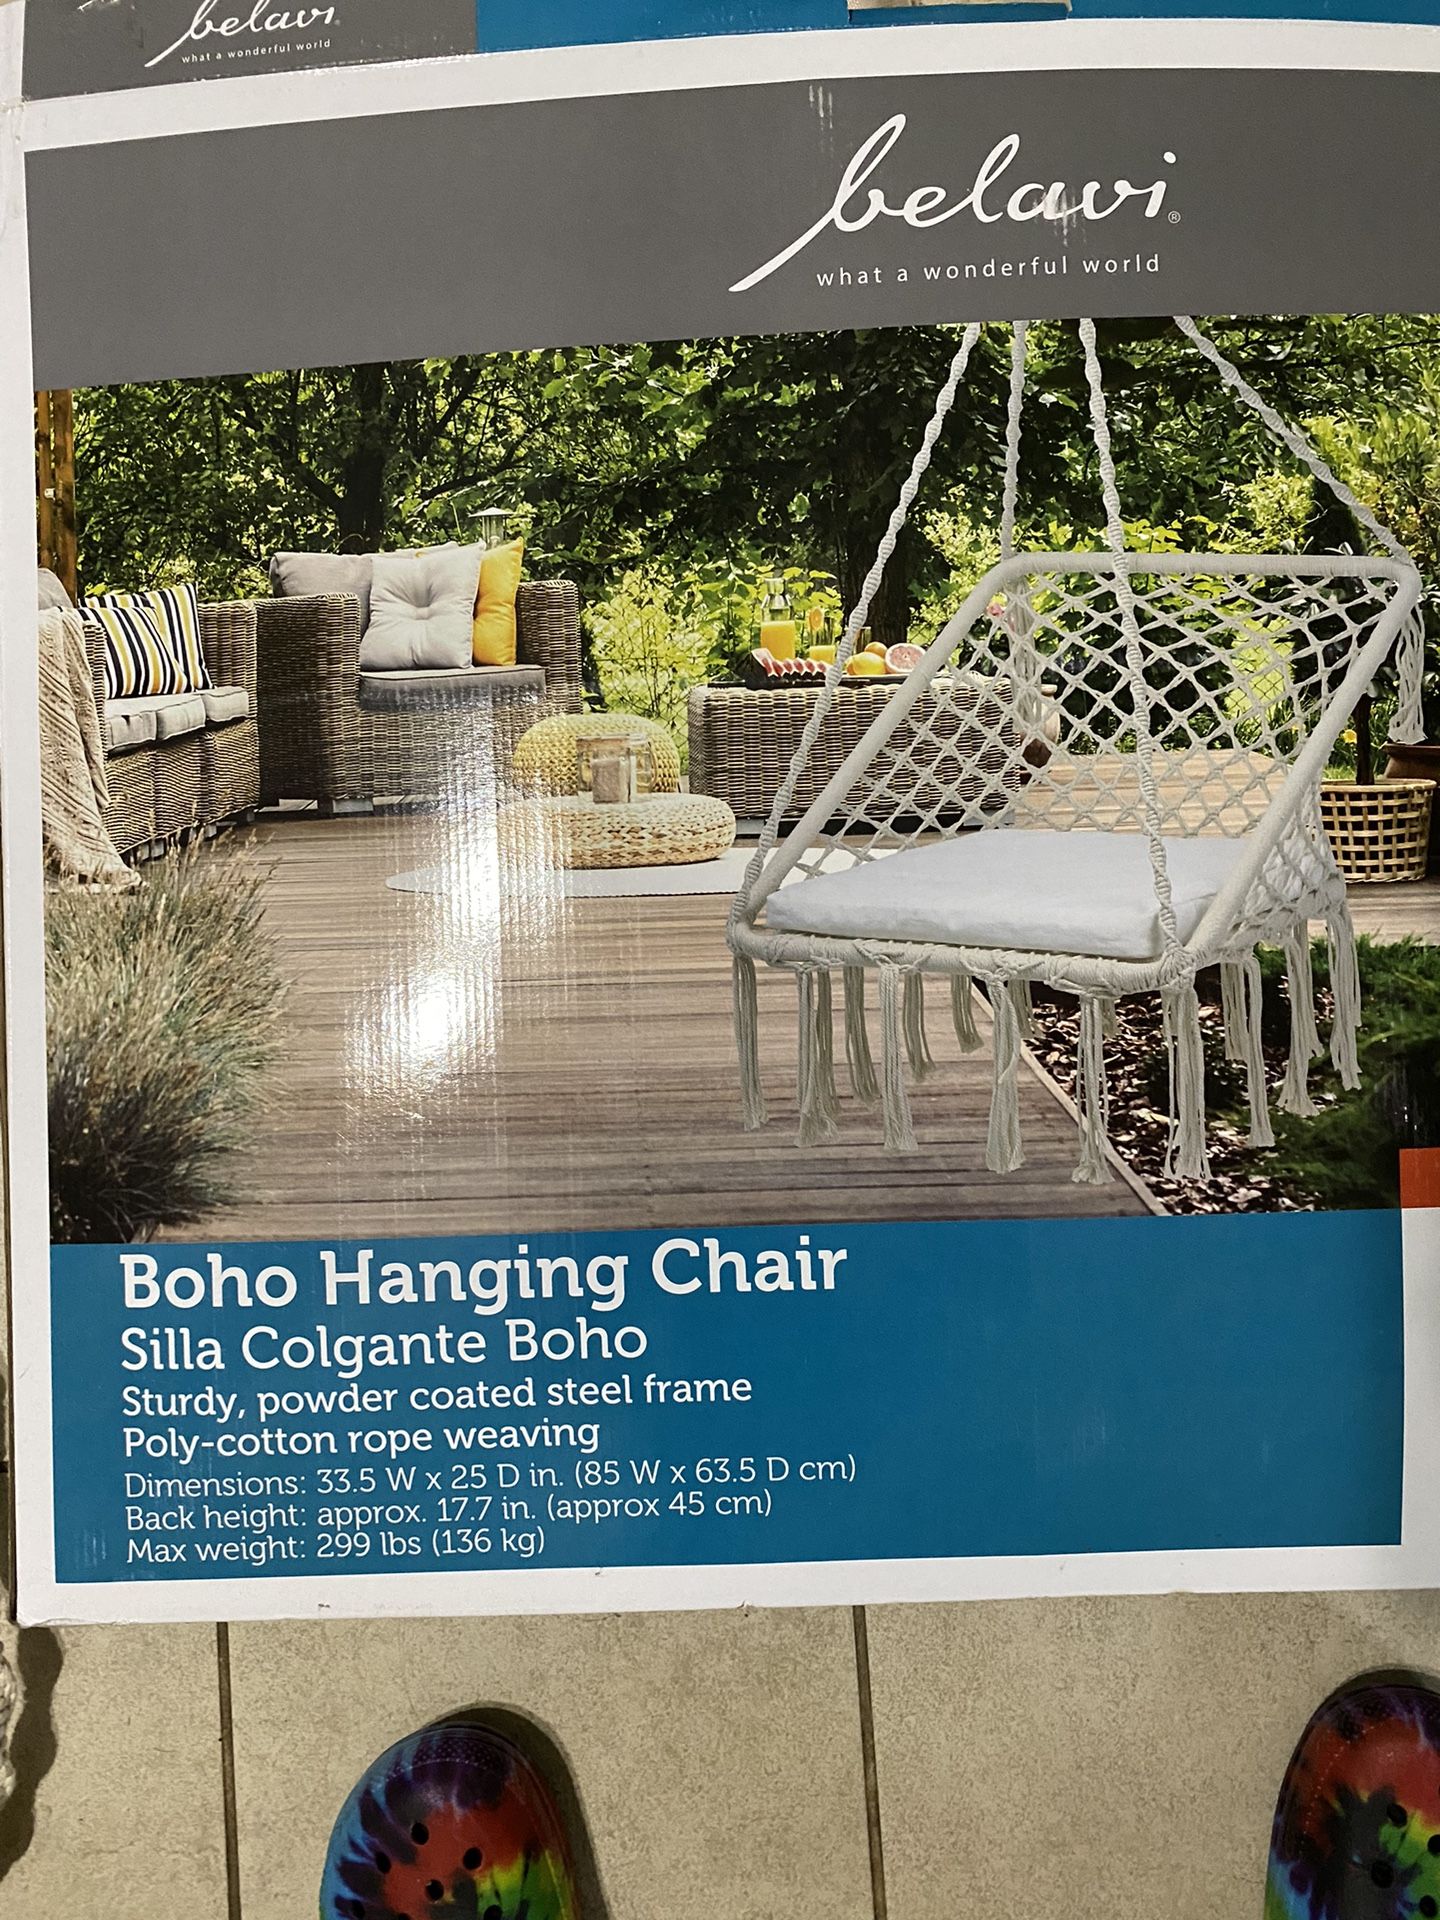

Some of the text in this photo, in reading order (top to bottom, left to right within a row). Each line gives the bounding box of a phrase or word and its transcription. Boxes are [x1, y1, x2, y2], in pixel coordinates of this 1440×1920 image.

[144, 0, 335, 67] belavi
[181, 38, 332, 64] what a wonderful world
[728, 113, 1177, 292] belavi
[816, 253, 1159, 287] what a wonderful world
[119, 1235, 848, 1316] Boho Hanging Chair
[121, 1316, 648, 1379] Silla Colgante Boho
[122, 1373, 752, 1423] Sturdy, powder coated steel frame
[122, 1417, 600, 1465] Poly-cotton rope weaving
[124, 1453, 856, 1499] Dimensions: 33.5 W x 25 D in. (85 W x 63.5 D cm)
[125, 1486, 772, 1534] Back height: approx. 17.7 in. (approx 45 cm)
[126, 1525, 545, 1567] Max weight: 299 lbs (136 kg)
